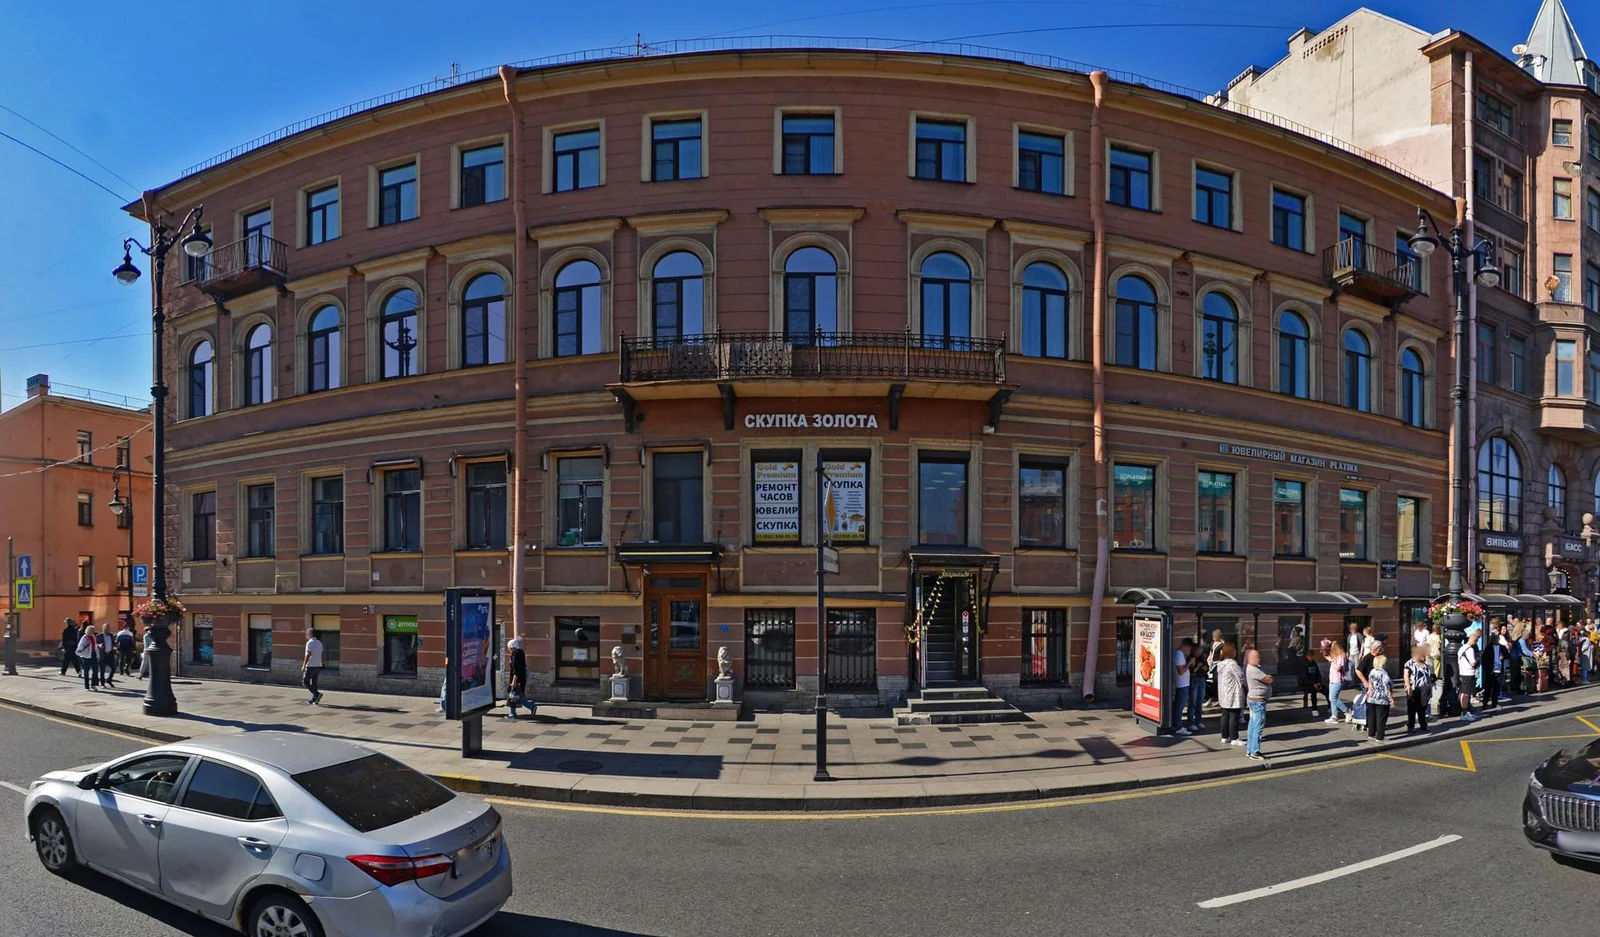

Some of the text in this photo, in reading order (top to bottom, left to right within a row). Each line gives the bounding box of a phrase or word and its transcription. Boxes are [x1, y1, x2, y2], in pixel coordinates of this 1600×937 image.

[744, 414, 878, 428] СКУПКА ЗОЛОТА
[1231, 446, 1359, 472] ЮВЕЛИРНЫЙ МАГАЗИН PLATINA
[757, 463, 777, 471] Gold
[825, 463, 845, 471] Gold
[756, 483, 797, 491] РЕМОНТ
[824, 481, 863, 489] СКУПКА
[760, 493, 793, 501] ЧАСОВ
[756, 506, 798, 515] ЮВЕЛИР
[756, 521, 798, 530] СКУПКА
[1486, 537, 1519, 548] ВИЛЬЯМ
[1565, 542, 1582, 551] БАСС
